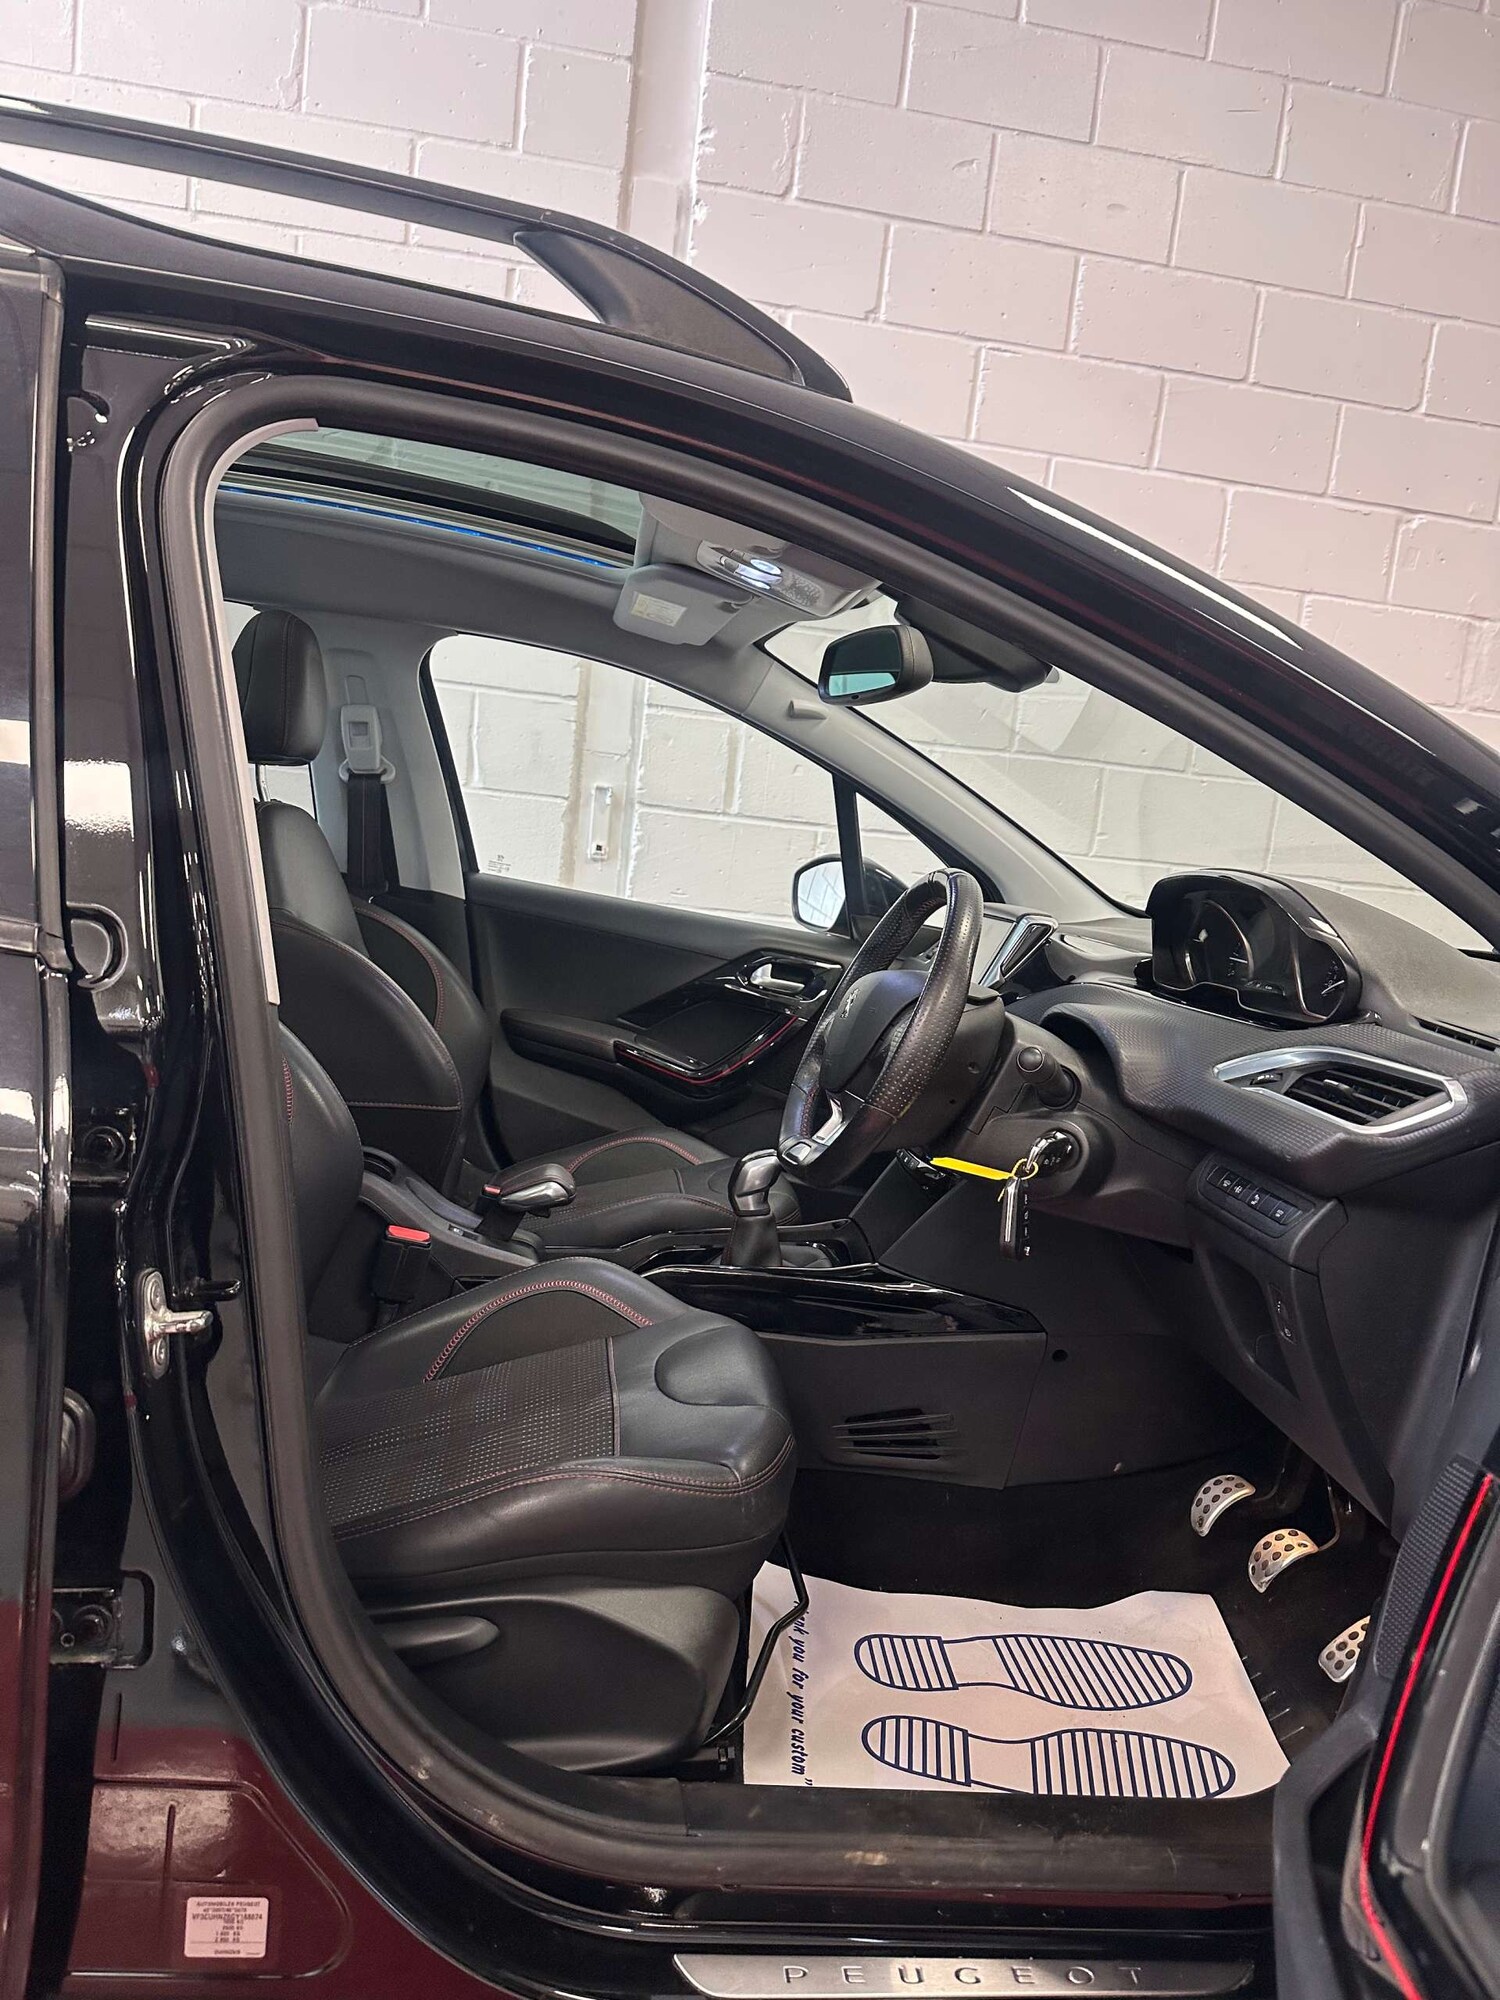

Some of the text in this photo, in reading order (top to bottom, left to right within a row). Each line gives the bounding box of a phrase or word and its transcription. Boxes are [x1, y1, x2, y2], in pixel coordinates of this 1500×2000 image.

[788, 1635, 806, 1663] you
[792, 1667, 809, 1690] for
[786, 1691, 805, 1724] your
[782, 1964, 1142, 1986] PEUGEOT
